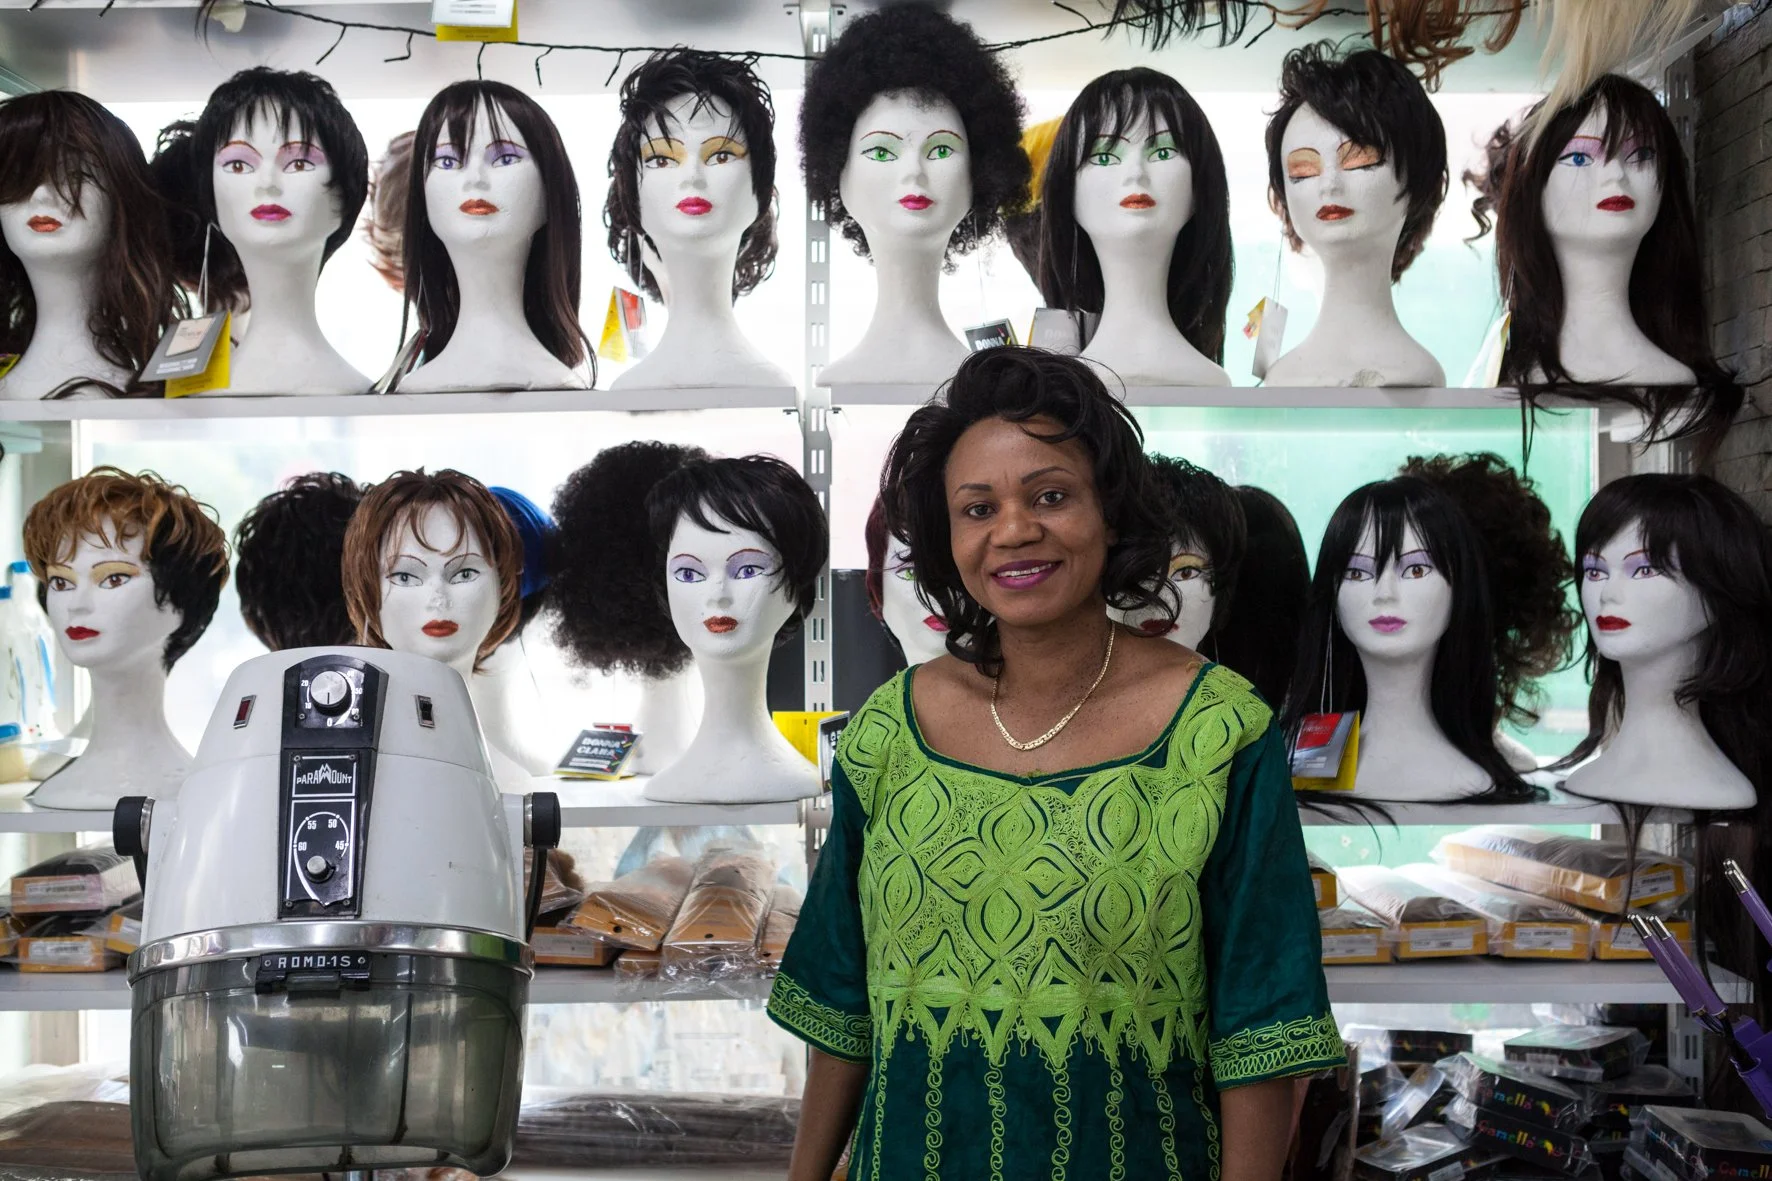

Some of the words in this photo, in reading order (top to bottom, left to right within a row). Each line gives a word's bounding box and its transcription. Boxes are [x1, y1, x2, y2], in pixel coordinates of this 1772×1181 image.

[974, 335, 1006, 351] DONNA
[326, 717, 333, 727] 0
[581, 737, 620, 748] DONNA
[576, 746, 615, 756] CLARA
[296, 763, 352, 785] PARAMOUNT
[307, 820, 317, 830] 55
[327, 819, 337, 829] 50
[297, 841, 307, 851] 60
[334, 840, 345, 851] 45
[278, 955, 351, 969] ROMO-1S
[1719, 1161, 1772, 1180] Camell
